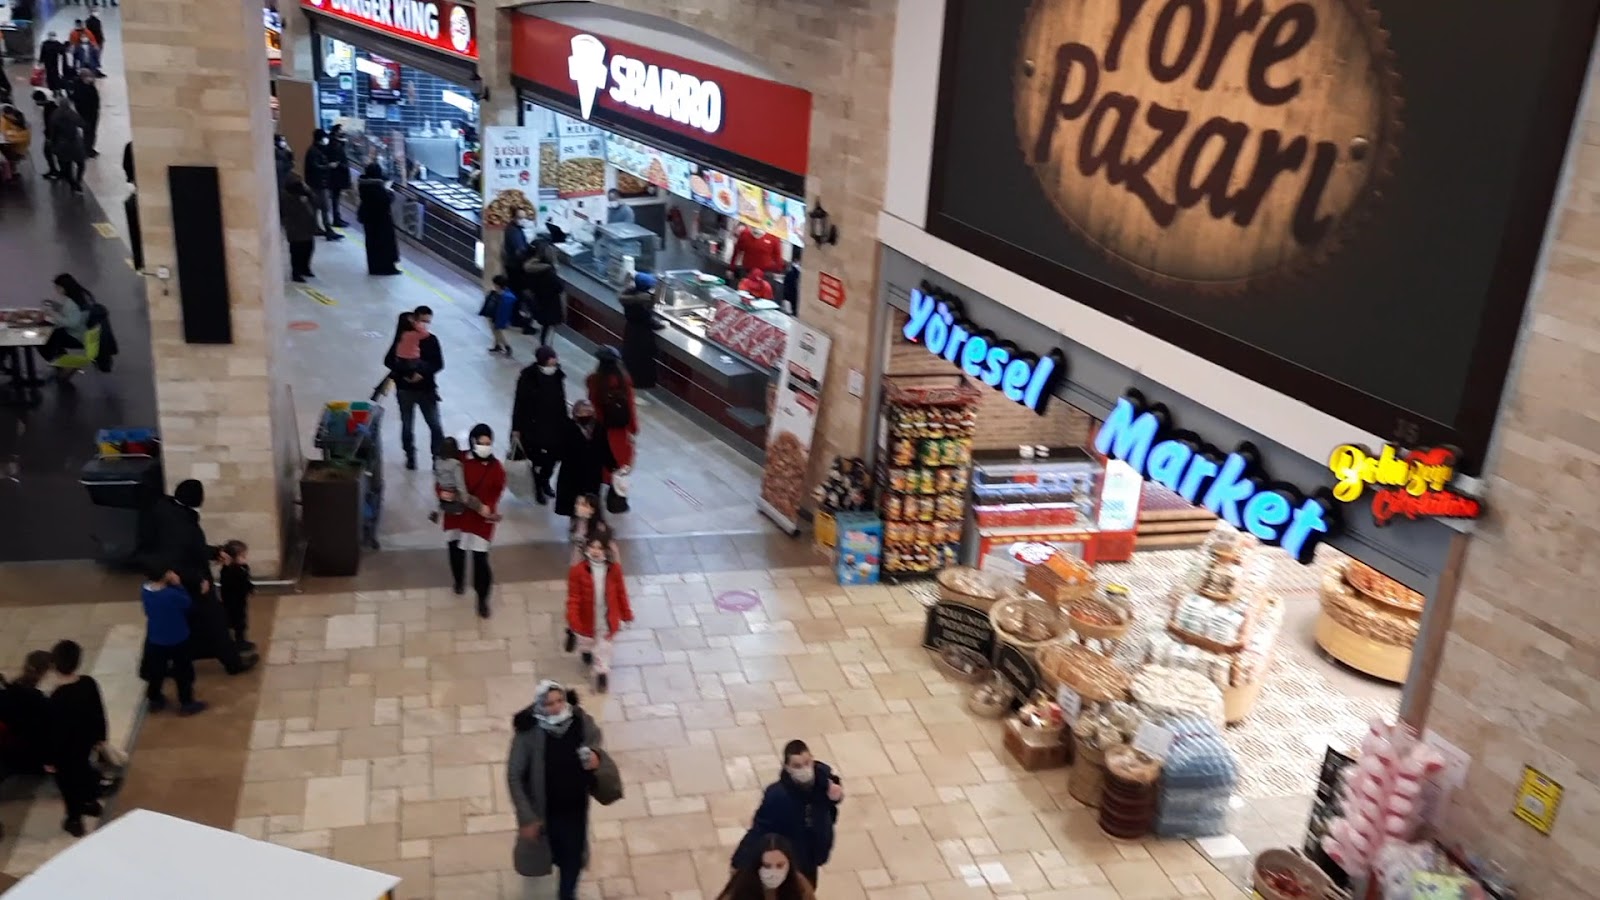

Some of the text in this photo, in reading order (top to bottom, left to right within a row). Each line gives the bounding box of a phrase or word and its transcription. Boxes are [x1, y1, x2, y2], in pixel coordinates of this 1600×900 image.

[394, 0, 439, 40] KING
[609, 54, 722, 133] SBARRO
[1034, 42, 1337, 246] Pazarı
[1094, 396, 1328, 560] Market
